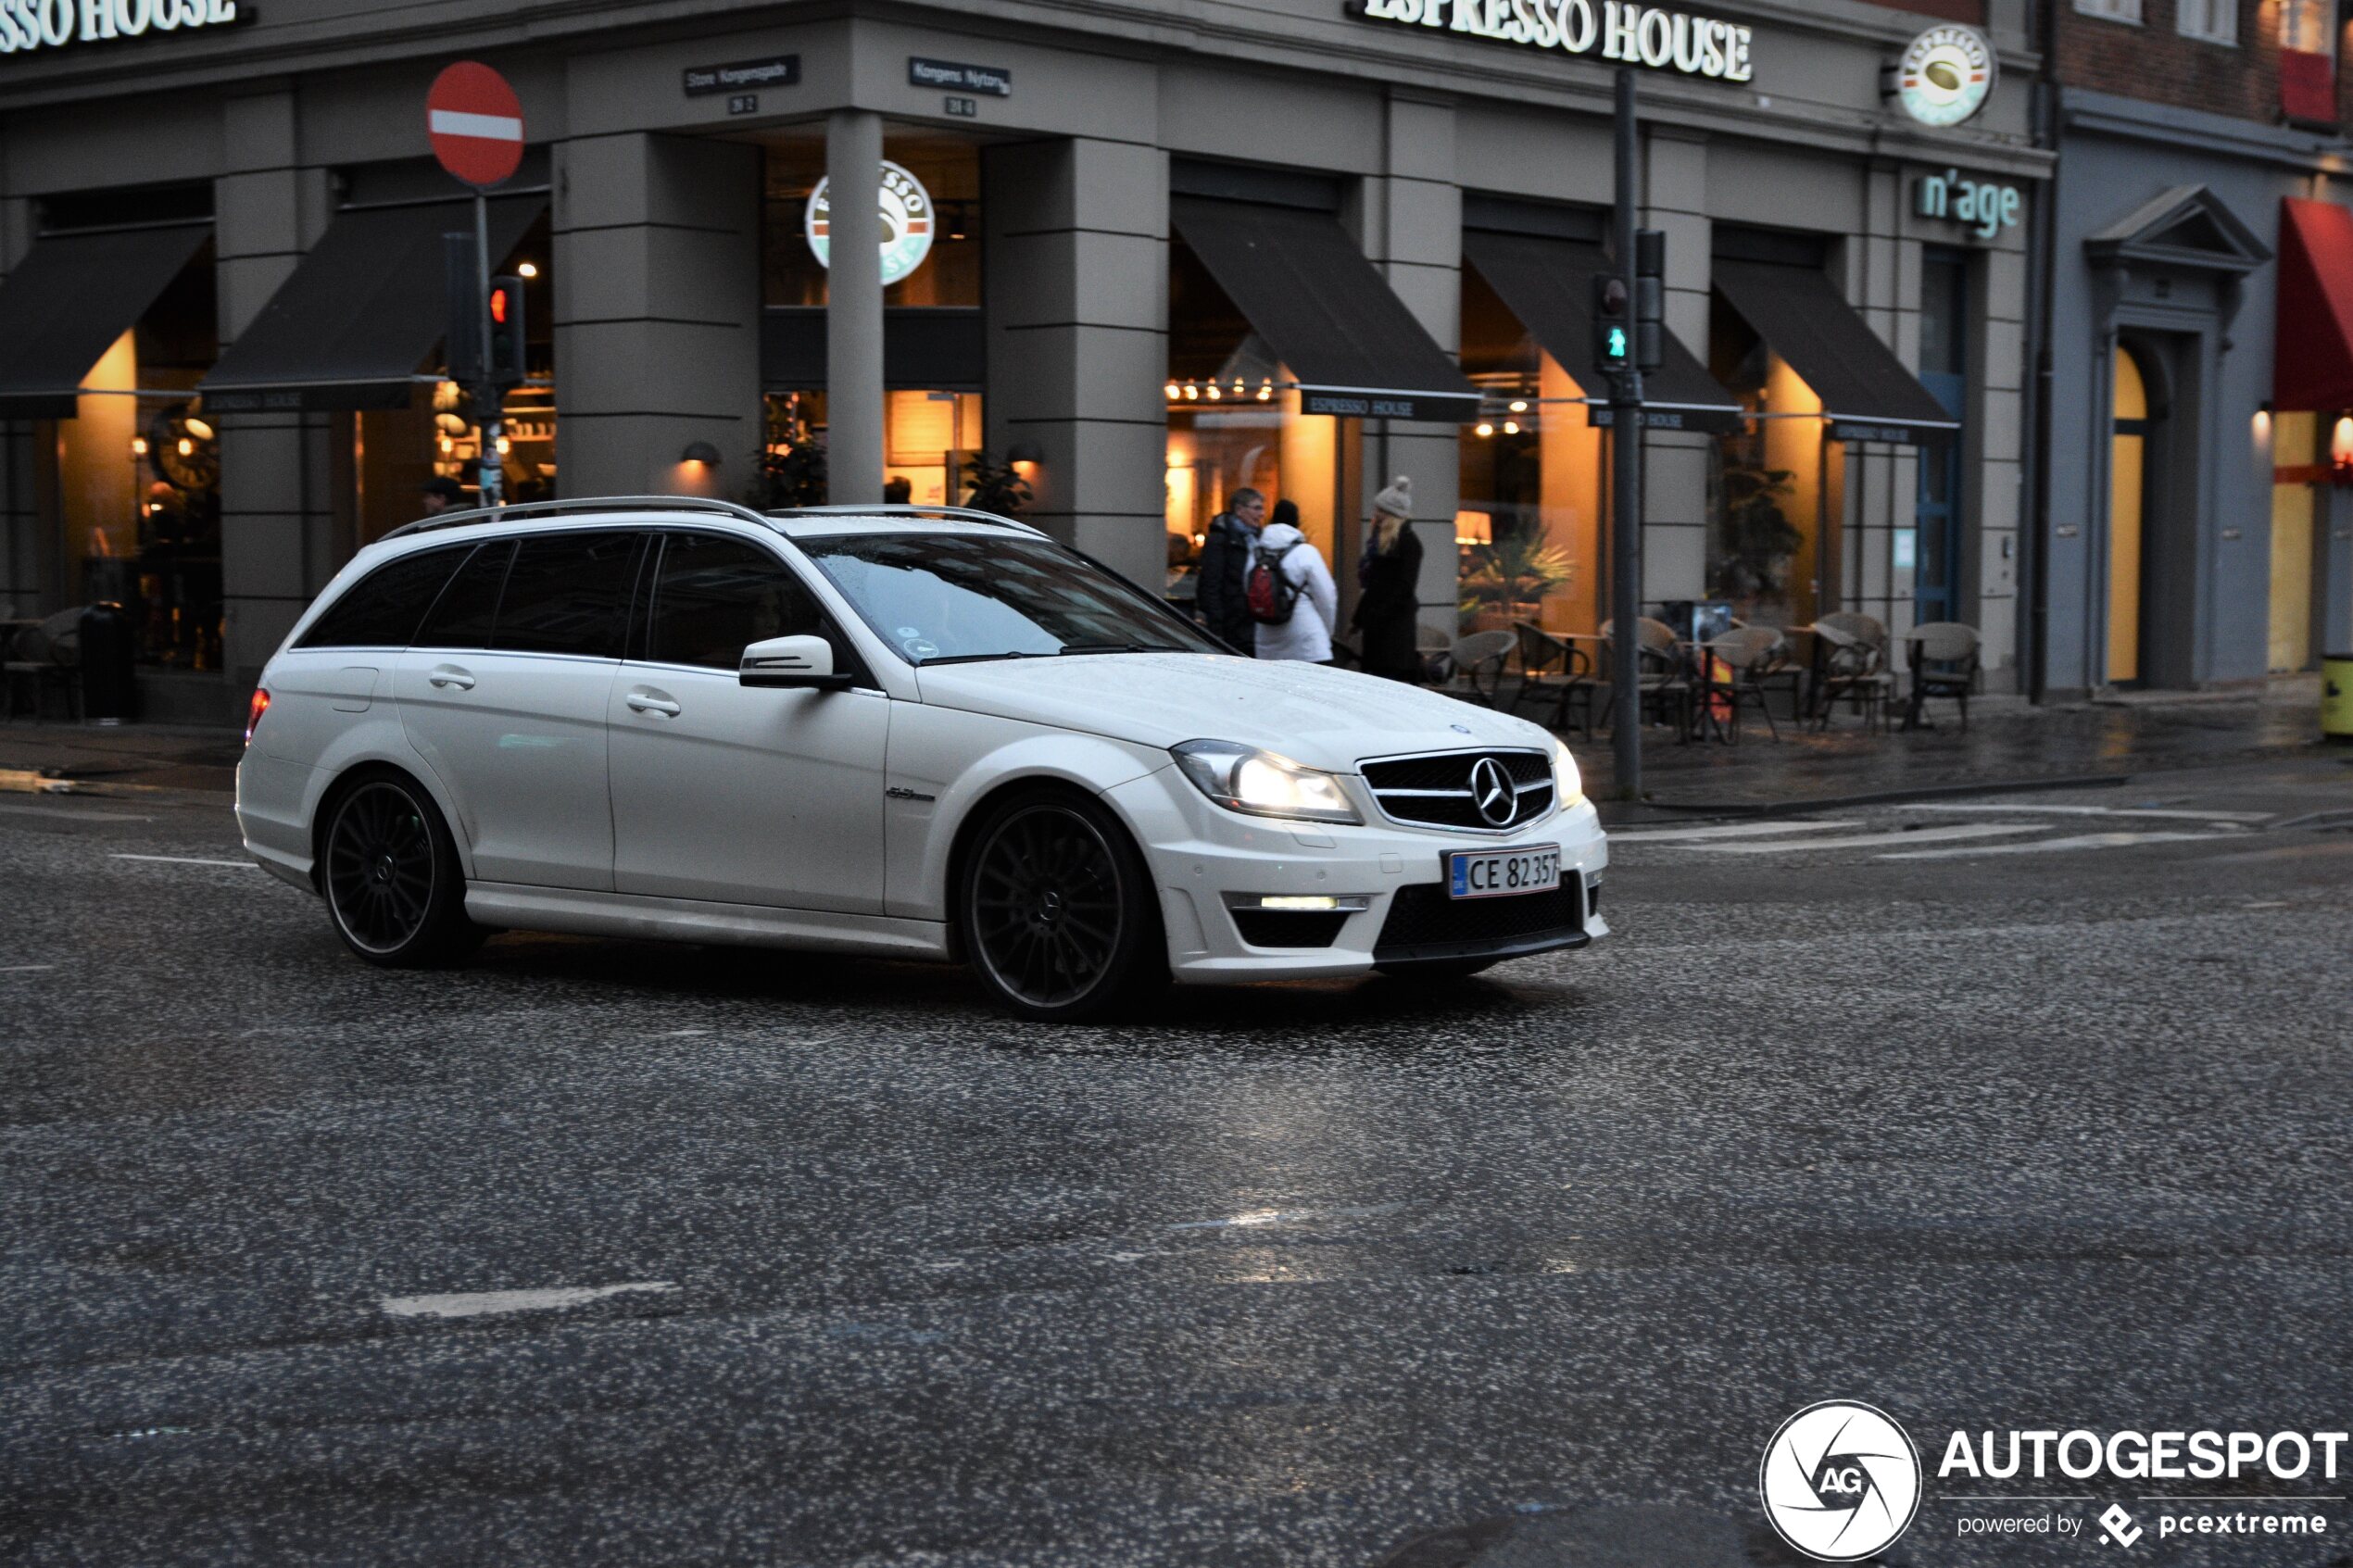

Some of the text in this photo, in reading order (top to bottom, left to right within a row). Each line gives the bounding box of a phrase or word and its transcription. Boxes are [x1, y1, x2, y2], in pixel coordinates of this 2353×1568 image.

[1603, 0, 1753, 82] HOUSE
[1924, 168, 2020, 238] n'age
[1310, 396, 1414, 417] ESPRESSO HOUSE
[1470, 853, 1557, 889] CE 82 357
